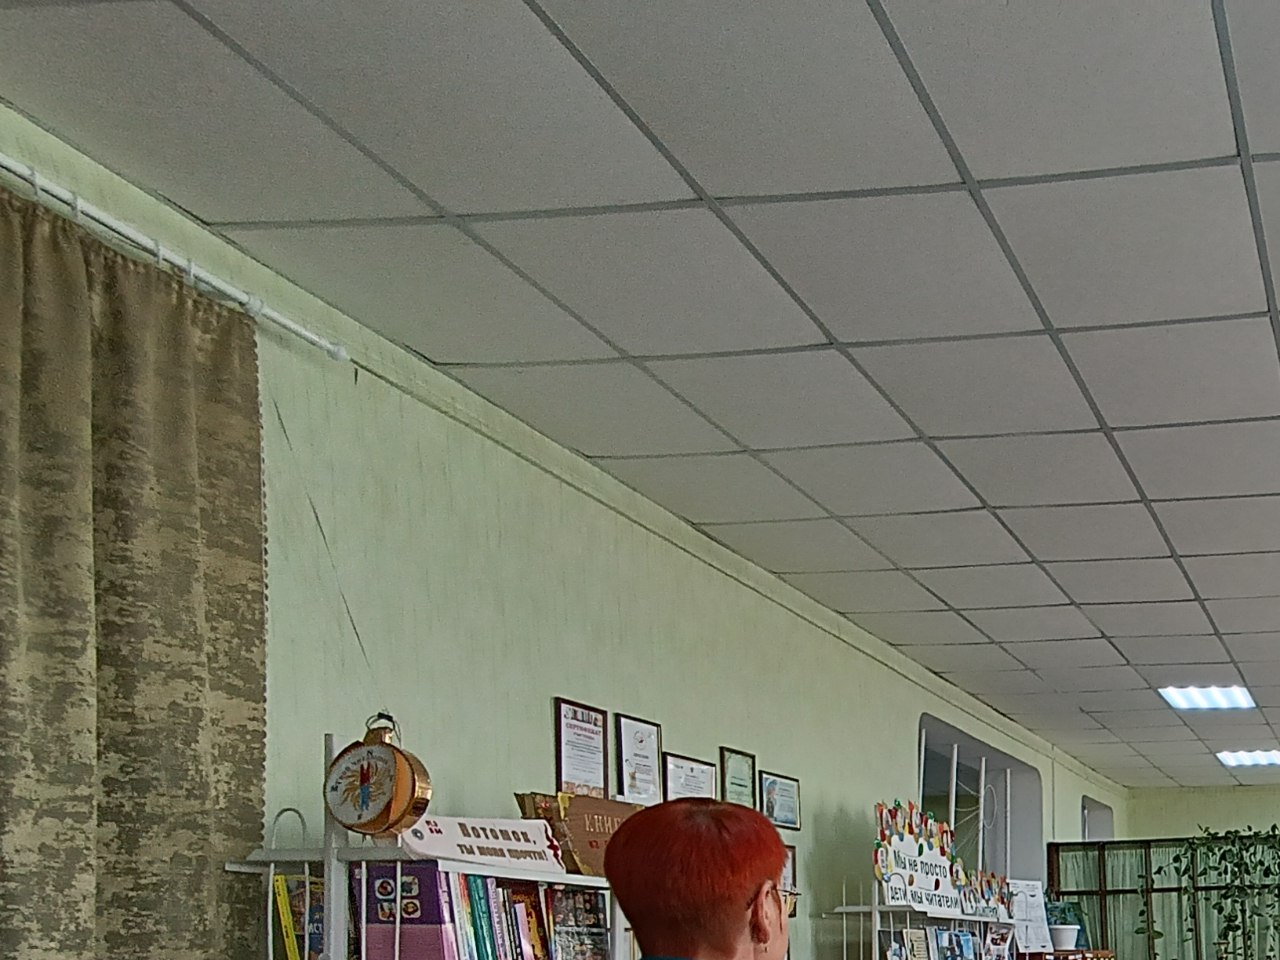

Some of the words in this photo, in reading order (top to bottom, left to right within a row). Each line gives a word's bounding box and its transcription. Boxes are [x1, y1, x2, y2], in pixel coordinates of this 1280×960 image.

[584, 813, 624, 834] КНИГ
[893, 849, 906, 870] Мы
[908, 857, 918, 873] не
[920, 860, 948, 879] просто
